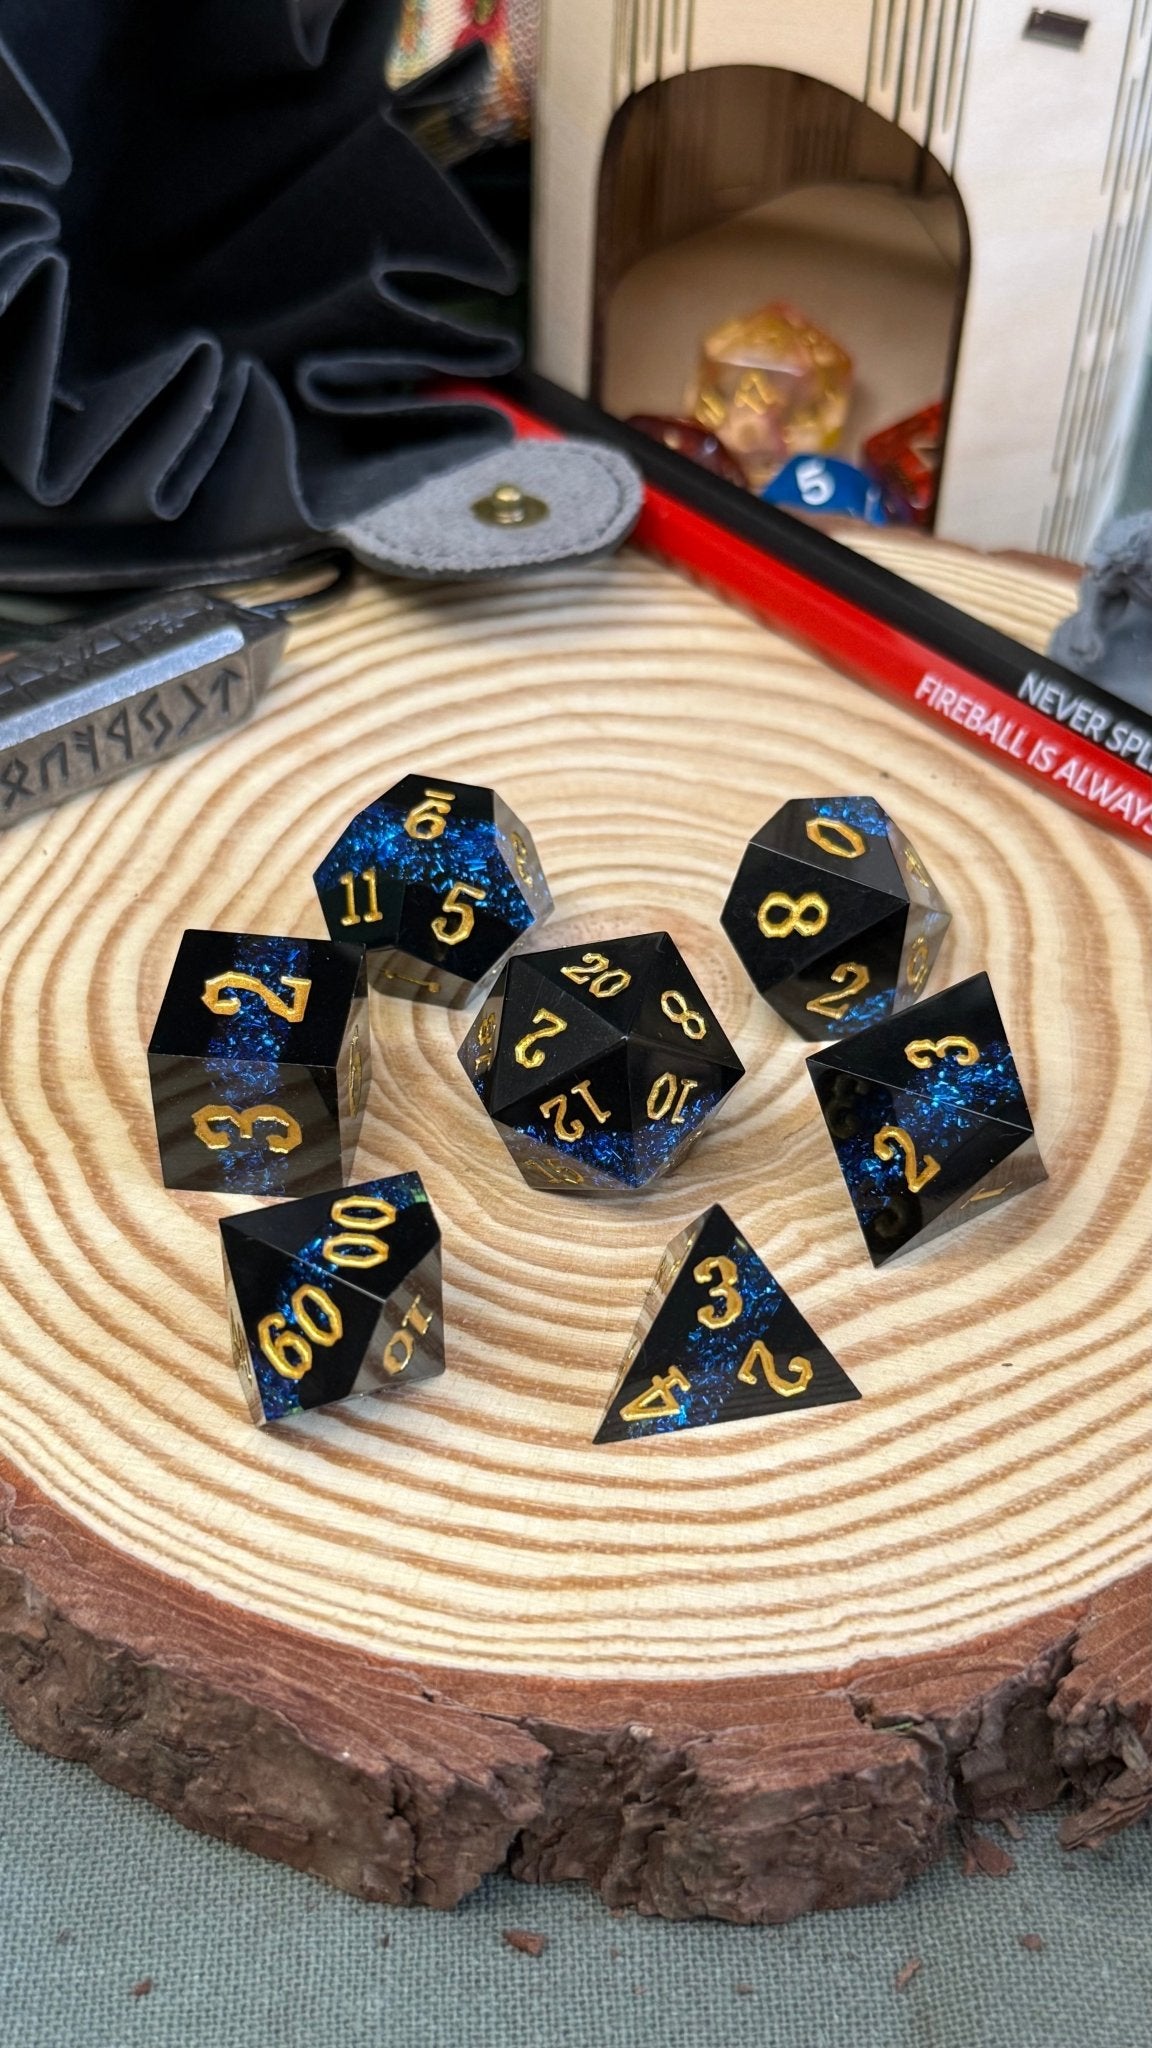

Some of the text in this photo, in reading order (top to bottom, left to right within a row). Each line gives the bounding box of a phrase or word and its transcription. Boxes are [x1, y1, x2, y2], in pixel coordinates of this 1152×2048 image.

[796, 458, 834, 505] 5
[915, 674, 1028, 758] FIREBALL
[1027, 739, 1058, 773] IS
[1018, 671, 1152, 774] NEVER SPL
[805, 817, 865, 859] 0
[340, 866, 383, 926] 11
[431, 881, 486, 945] 5
[757, 891, 829, 938] 8
[201, 971, 312, 1023] 2
[560, 952, 631, 998] 20
[807, 961, 870, 1020] 2
[514, 1007, 567, 1069] 2
[660, 990, 707, 1040] 8
[904, 1036, 980, 1069] 3
[539, 1079, 612, 1142] 12
[646, 1071, 698, 1125] 10
[191, 1104, 303, 1155] 3
[873, 1125, 941, 1193] 2
[322, 1195, 397, 1269] 00
[693, 1255, 743, 1330] 3
[257, 1284, 344, 1380] 60
[619, 1365, 691, 1422] 4
[737, 1340, 814, 1397] 2
